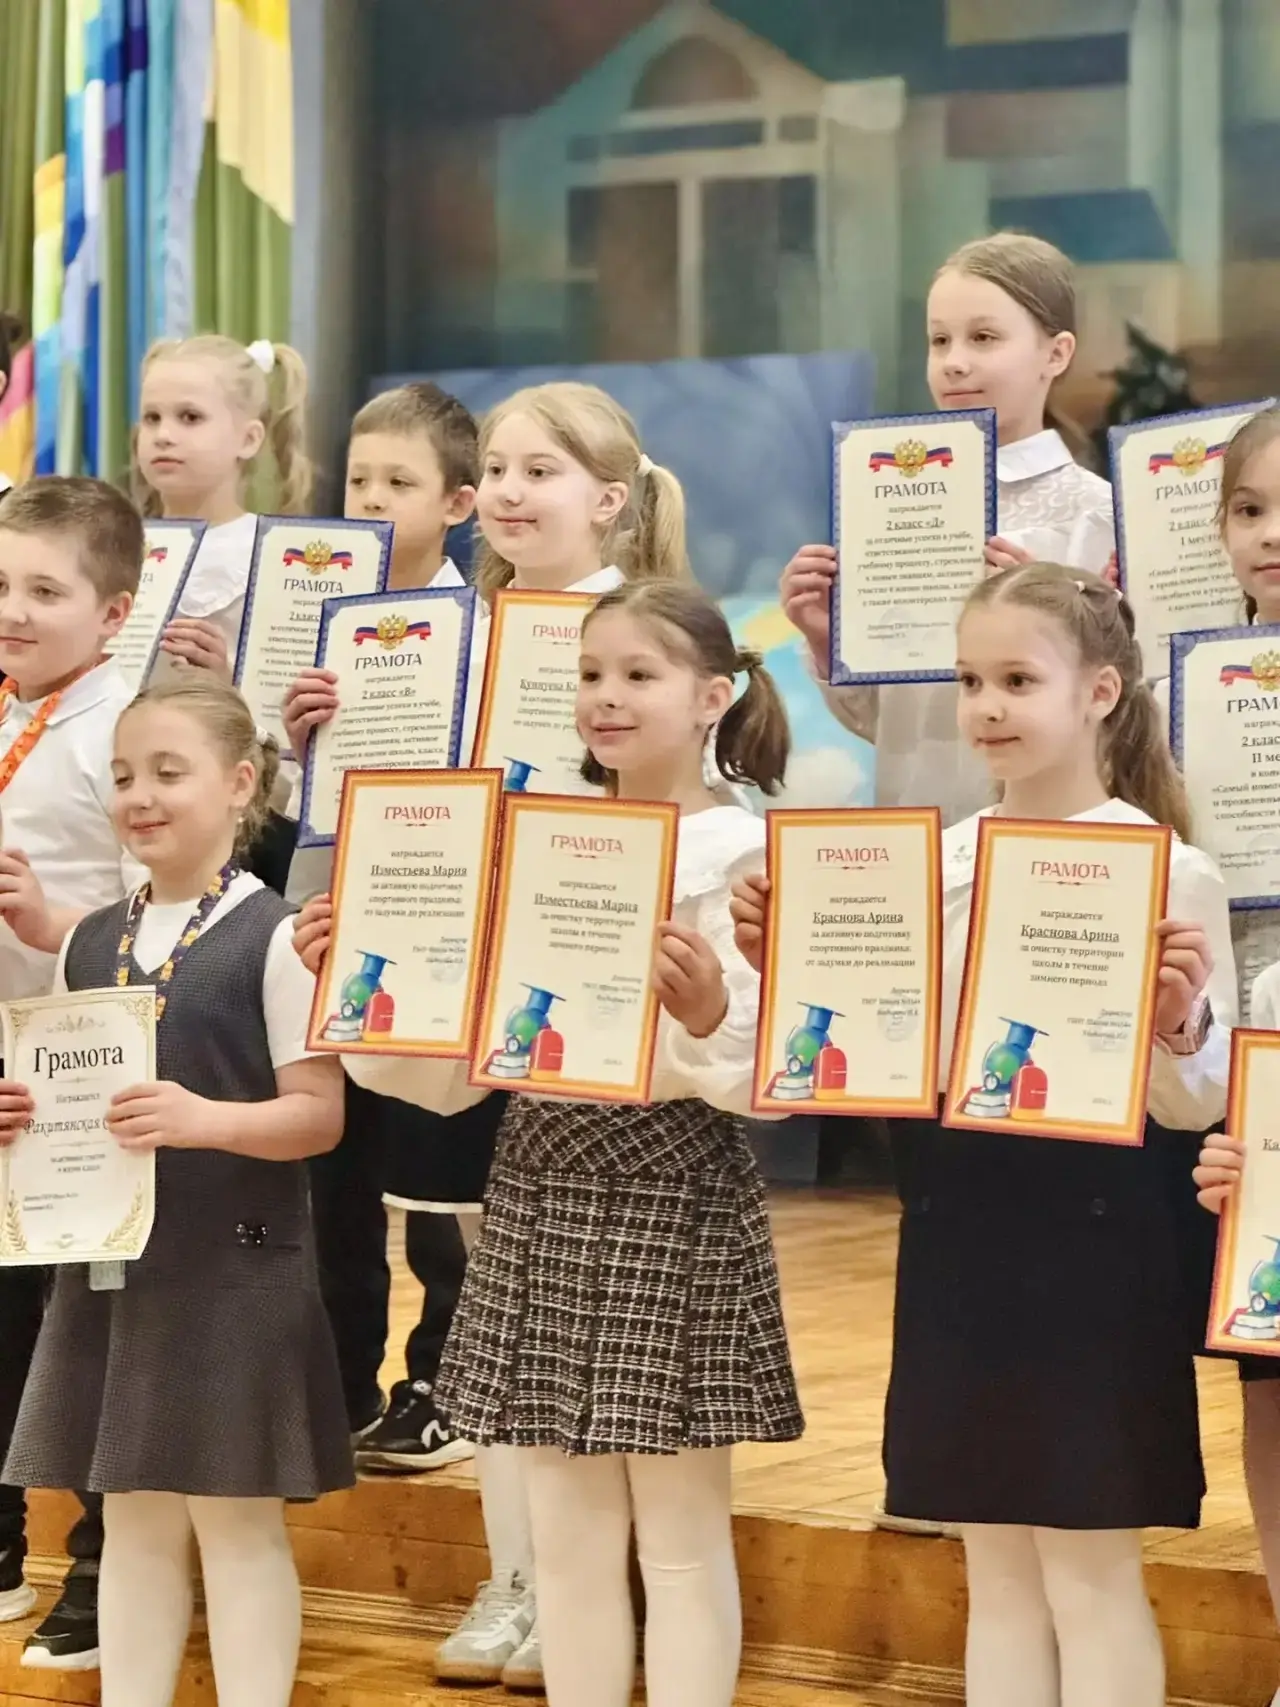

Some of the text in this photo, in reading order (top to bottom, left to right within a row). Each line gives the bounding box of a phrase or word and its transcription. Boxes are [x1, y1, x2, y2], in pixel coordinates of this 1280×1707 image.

[875, 482, 947, 498] ГРАМОТА
[1156, 478, 1220, 500] ГРАМОТ
[886, 521, 892, 530] 2
[894, 520, 923, 530] класс
[1169, 521, 1175, 531] 2
[284, 578, 344, 593] ГРАМОТА
[290, 612, 294, 620] 2
[533, 624, 580, 639] ГРАМО
[355, 653, 422, 670] ГРАМОТА
[566, 682, 578, 691] Ка
[362, 691, 368, 699] 2
[370, 690, 396, 698] класс
[1226, 697, 1280, 714] ГРАМ
[1241, 736, 1248, 747] 2
[384, 806, 451, 820] ГРАМОТА
[550, 834, 623, 854] ГРАМОТА
[816, 847, 889, 863] ГРАМОТА
[433, 865, 467, 878] Мария
[1031, 861, 1110, 880] ГРАМОТА
[600, 899, 638, 913] Мария
[813, 912, 903, 925] Краснова Арина
[1040, 910, 1103, 920] награждается
[1020, 924, 1119, 943] Краснова Арина
[34, 1045, 124, 1079] Грамота
[24, 1118, 100, 1137] Ракитянская
